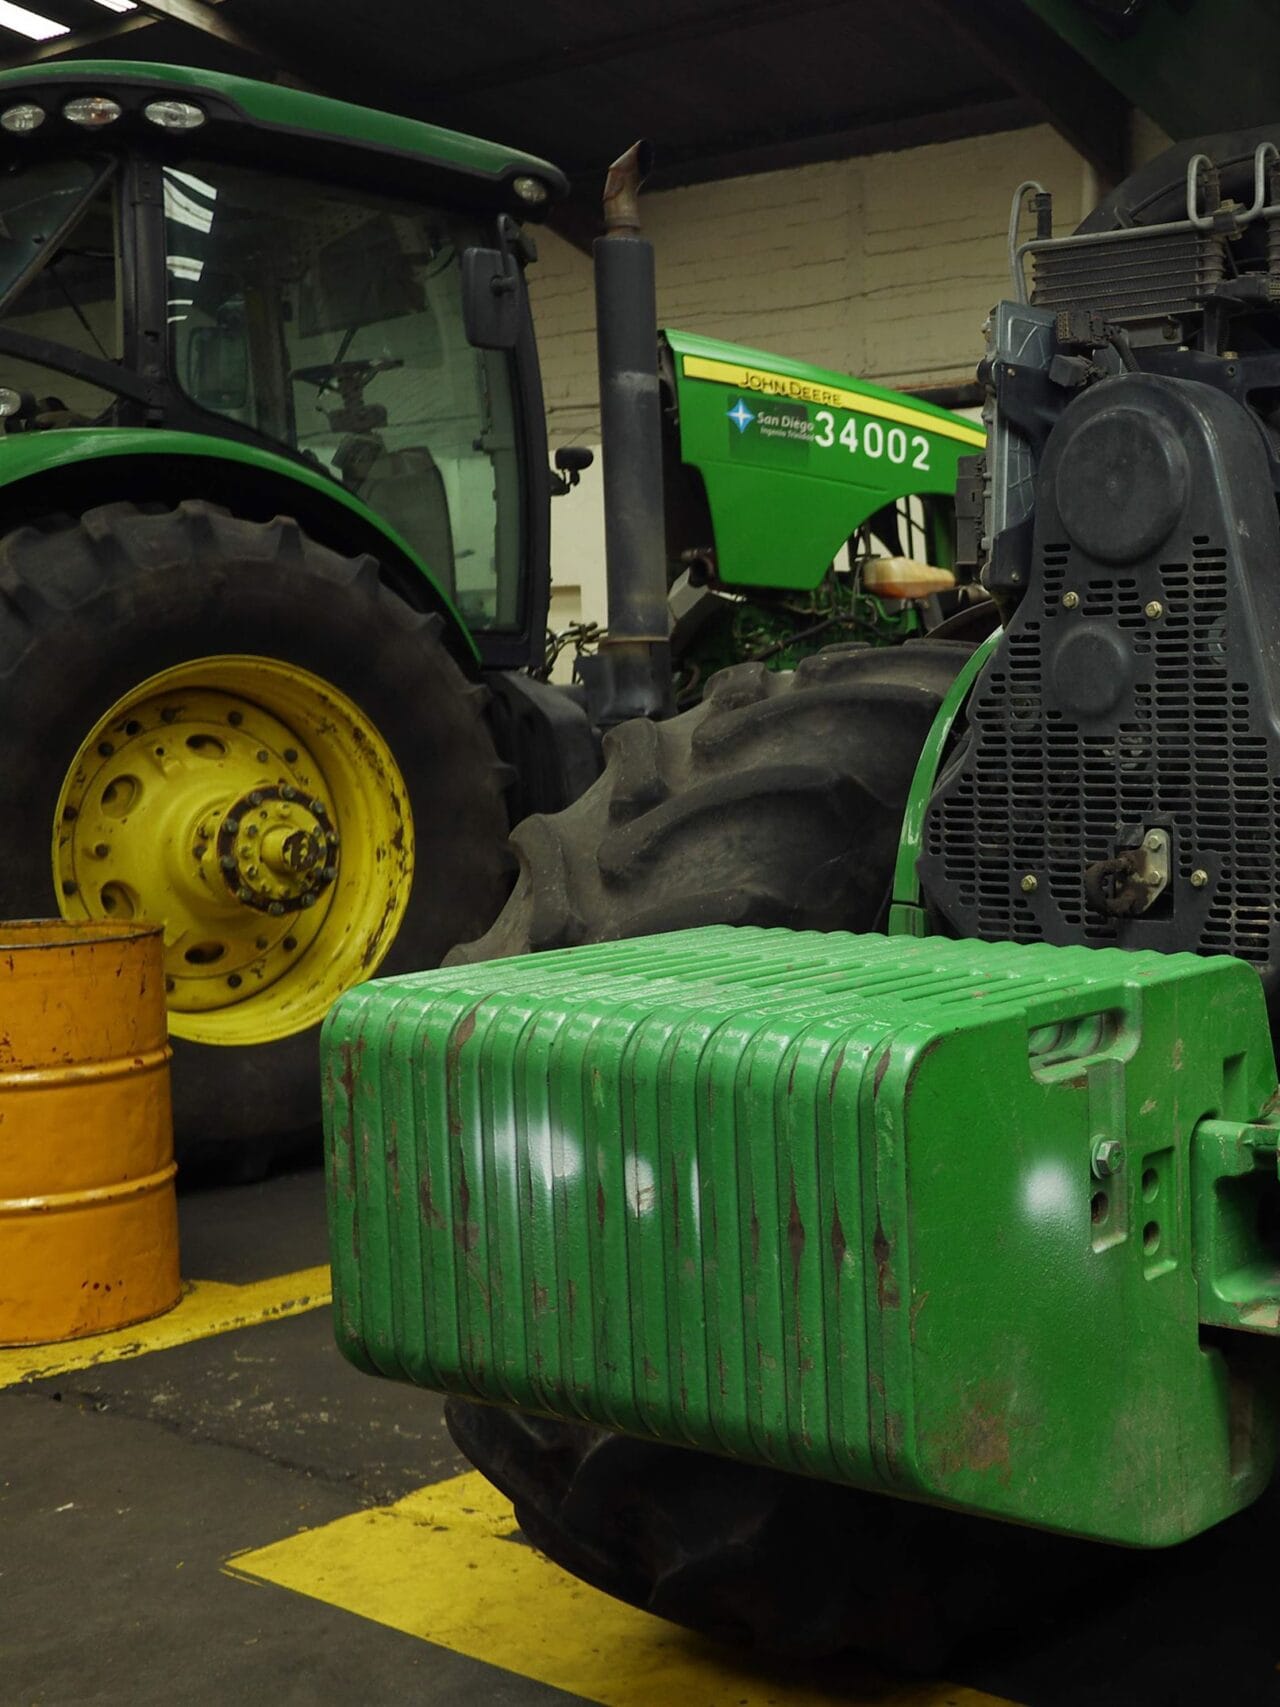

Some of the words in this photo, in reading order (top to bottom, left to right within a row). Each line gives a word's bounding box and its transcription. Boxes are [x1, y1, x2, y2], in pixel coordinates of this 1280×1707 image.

[741, 371, 785, 393] JOHN
[789, 381, 842, 405] DEERE
[757, 411, 780, 427] San
[815, 410, 930, 471] 34002
